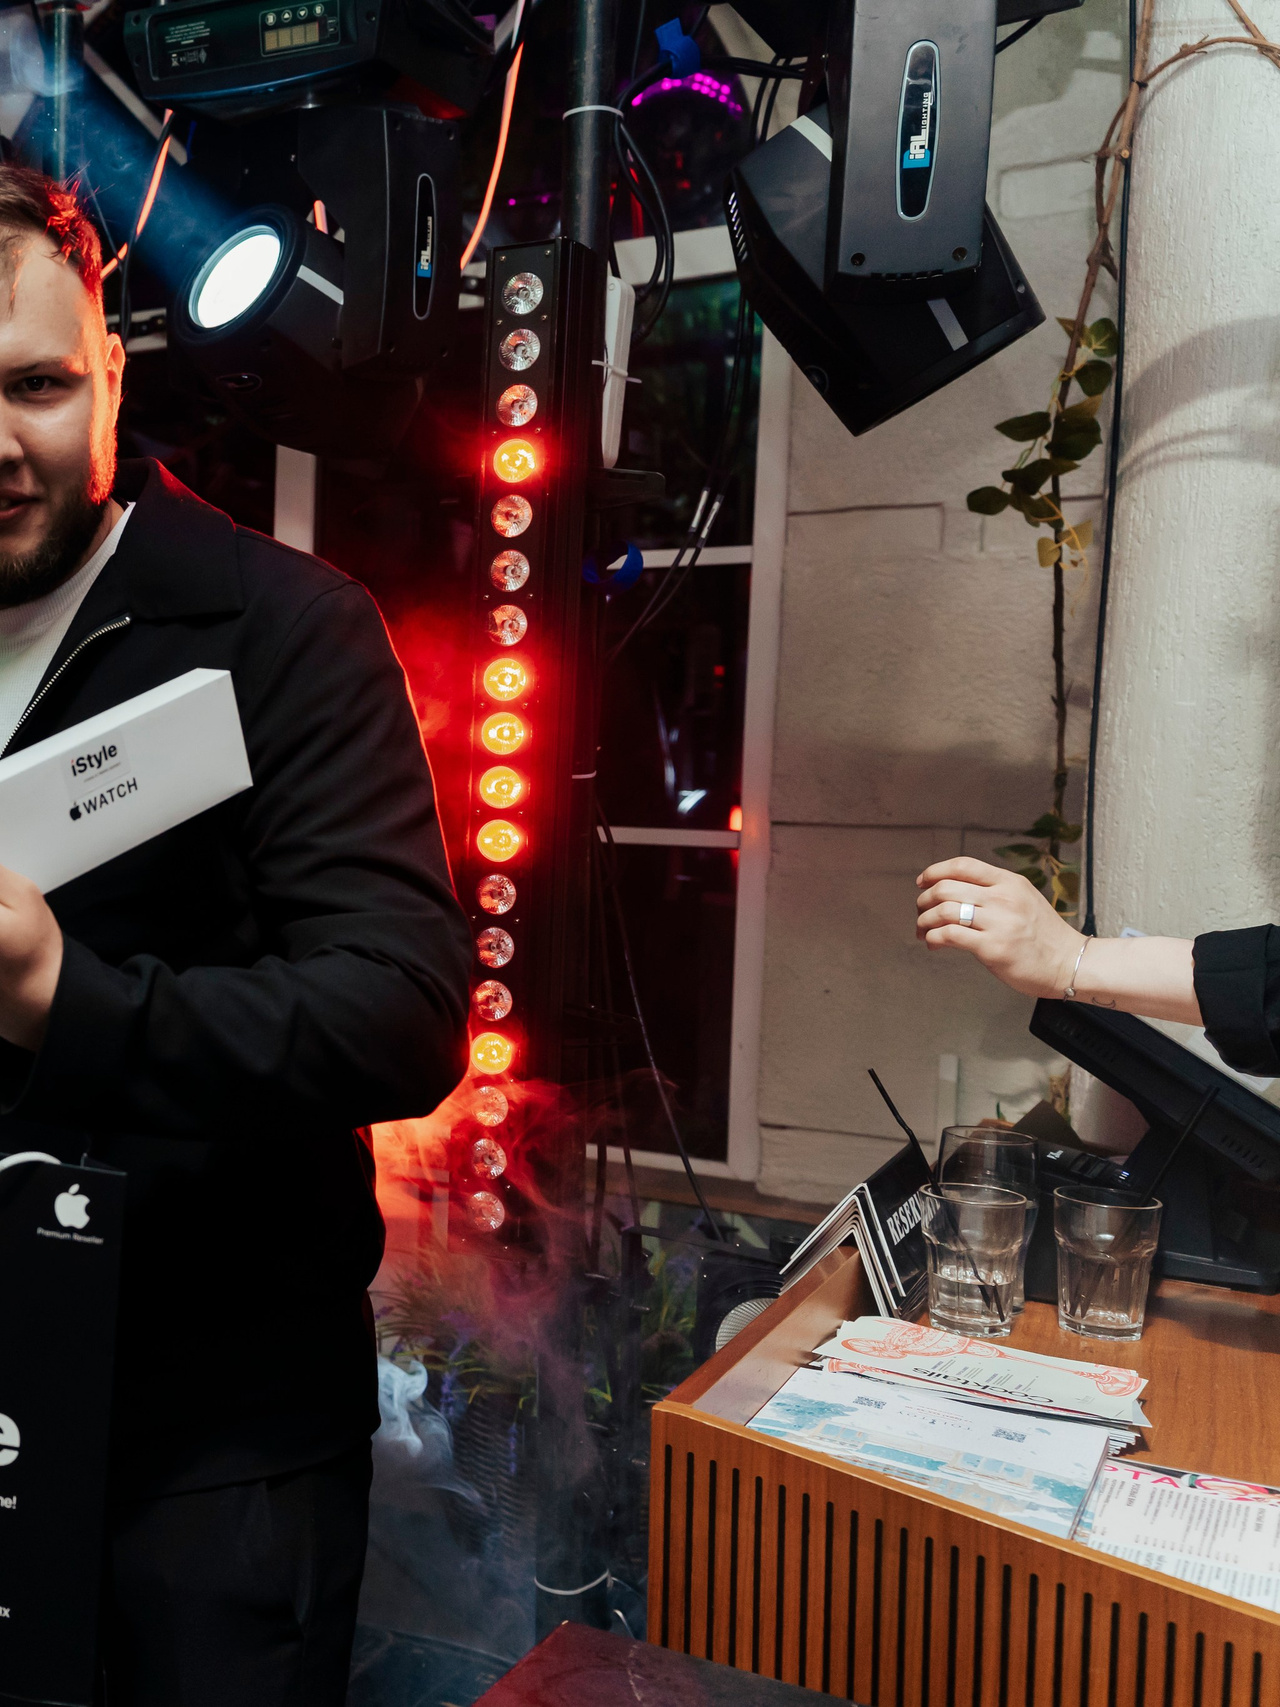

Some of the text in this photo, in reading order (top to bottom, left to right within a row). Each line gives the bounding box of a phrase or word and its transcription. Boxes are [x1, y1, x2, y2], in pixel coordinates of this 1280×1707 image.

[71, 744, 118, 776] iStyle
[83, 777, 138, 814] WATCH
[913, 1367, 1054, 1404] Cocktails
